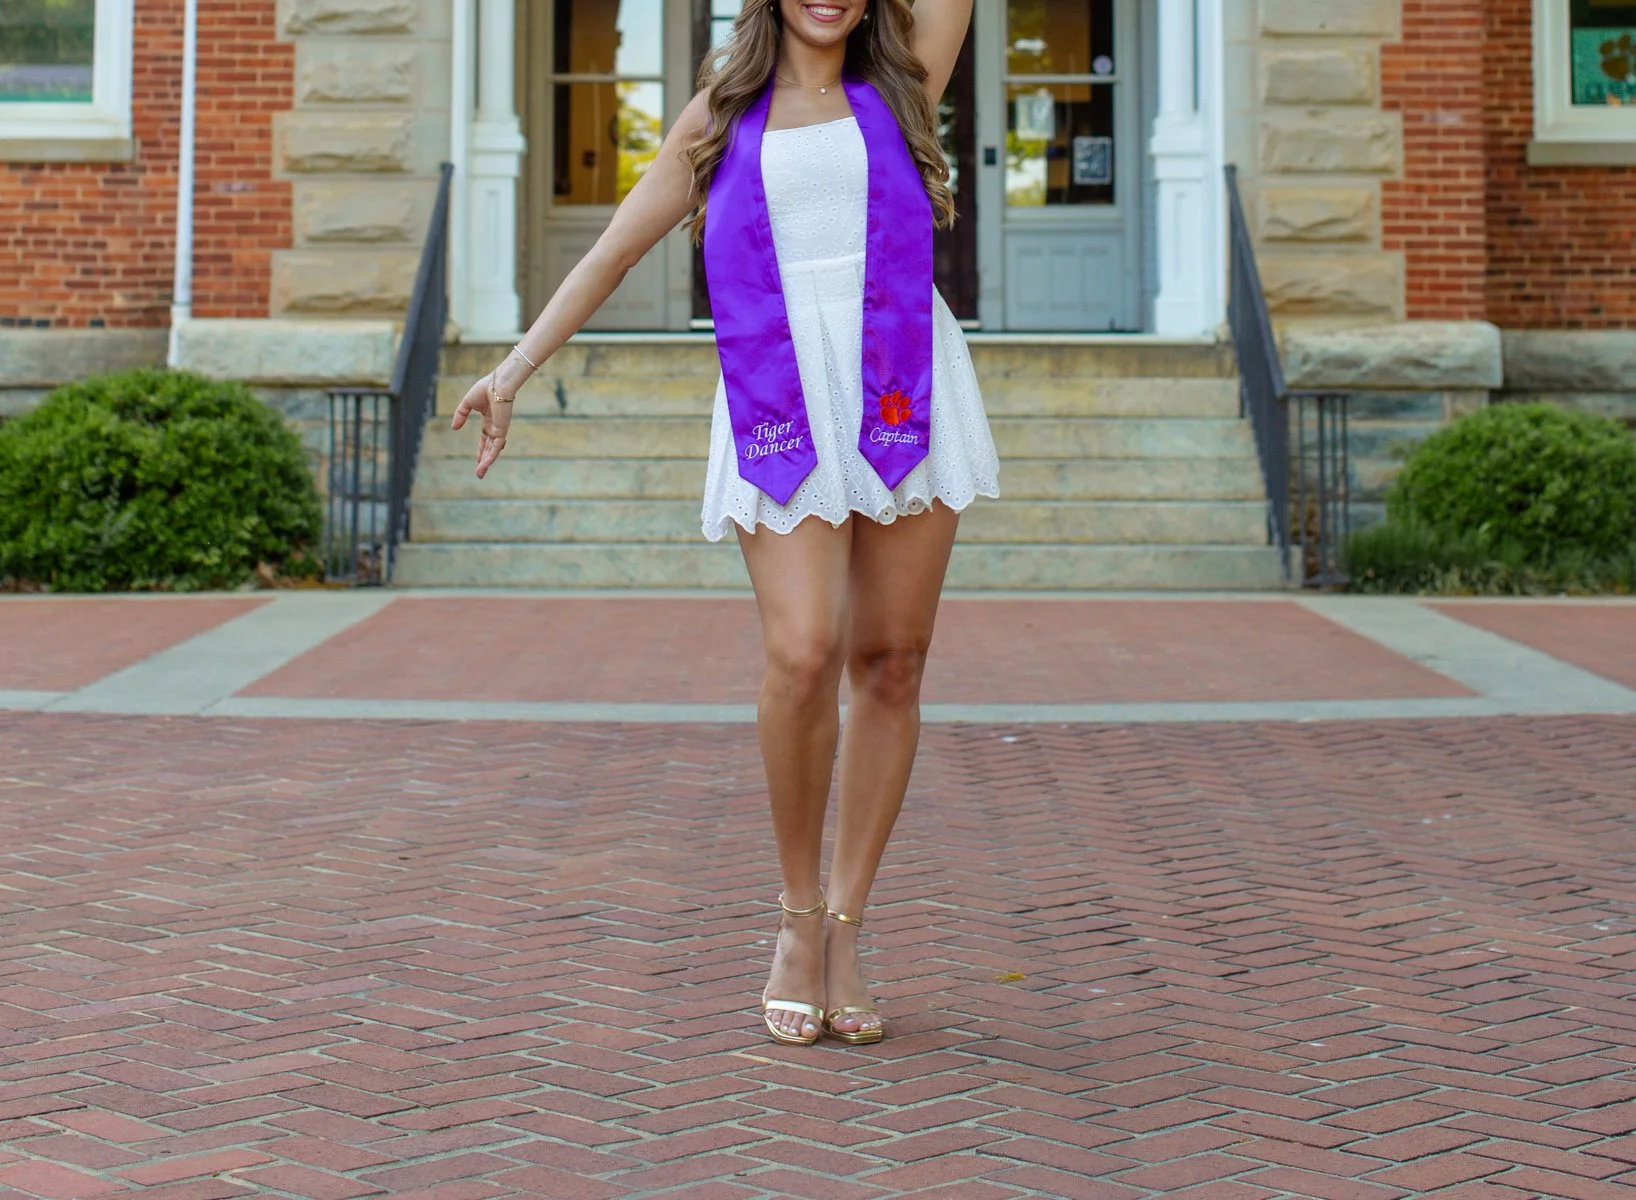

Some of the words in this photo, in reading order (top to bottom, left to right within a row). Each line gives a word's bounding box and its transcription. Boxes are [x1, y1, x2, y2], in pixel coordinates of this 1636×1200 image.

[752, 421, 793, 442] Tiger
[869, 427, 919, 447] Captain
[744, 435, 803, 460] Dancer
